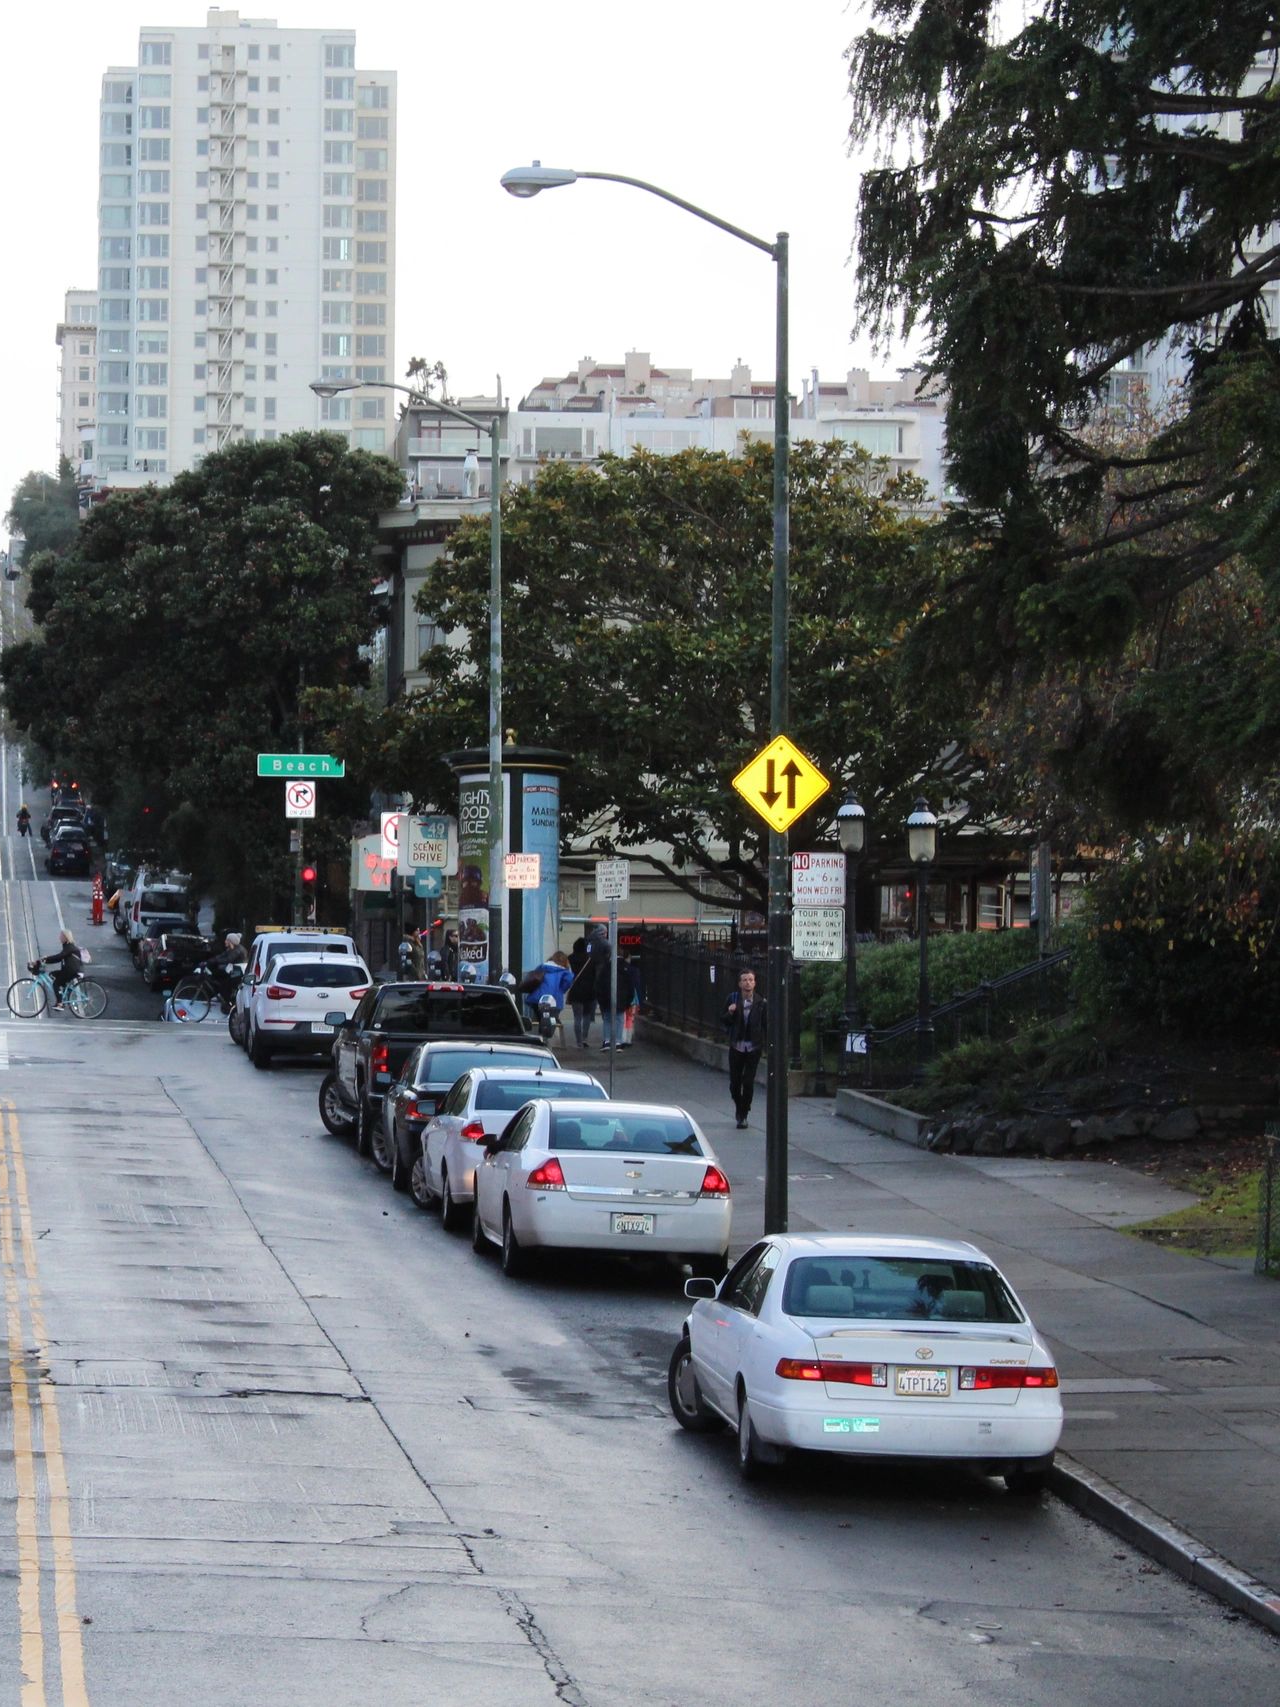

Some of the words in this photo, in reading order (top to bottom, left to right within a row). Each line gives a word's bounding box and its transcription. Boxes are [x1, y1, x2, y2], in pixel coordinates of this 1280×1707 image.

[272, 759, 330, 772] Beach
[428, 822, 445, 834] 49
[413, 843, 443, 852] SCENIC
[413, 852, 443, 862] DRIVE
[506, 854, 515, 864] NO
[794, 854, 809, 869] NO
[811, 858, 844, 869] PARKING
[797, 886, 813, 895] MON
[814, 886, 829, 895] WED
[830, 886, 842, 895] FRI
[798, 910, 818, 918] TOUR
[823, 910, 839, 918] BUS
[899, 1377, 947, 1392] 4TPT125
